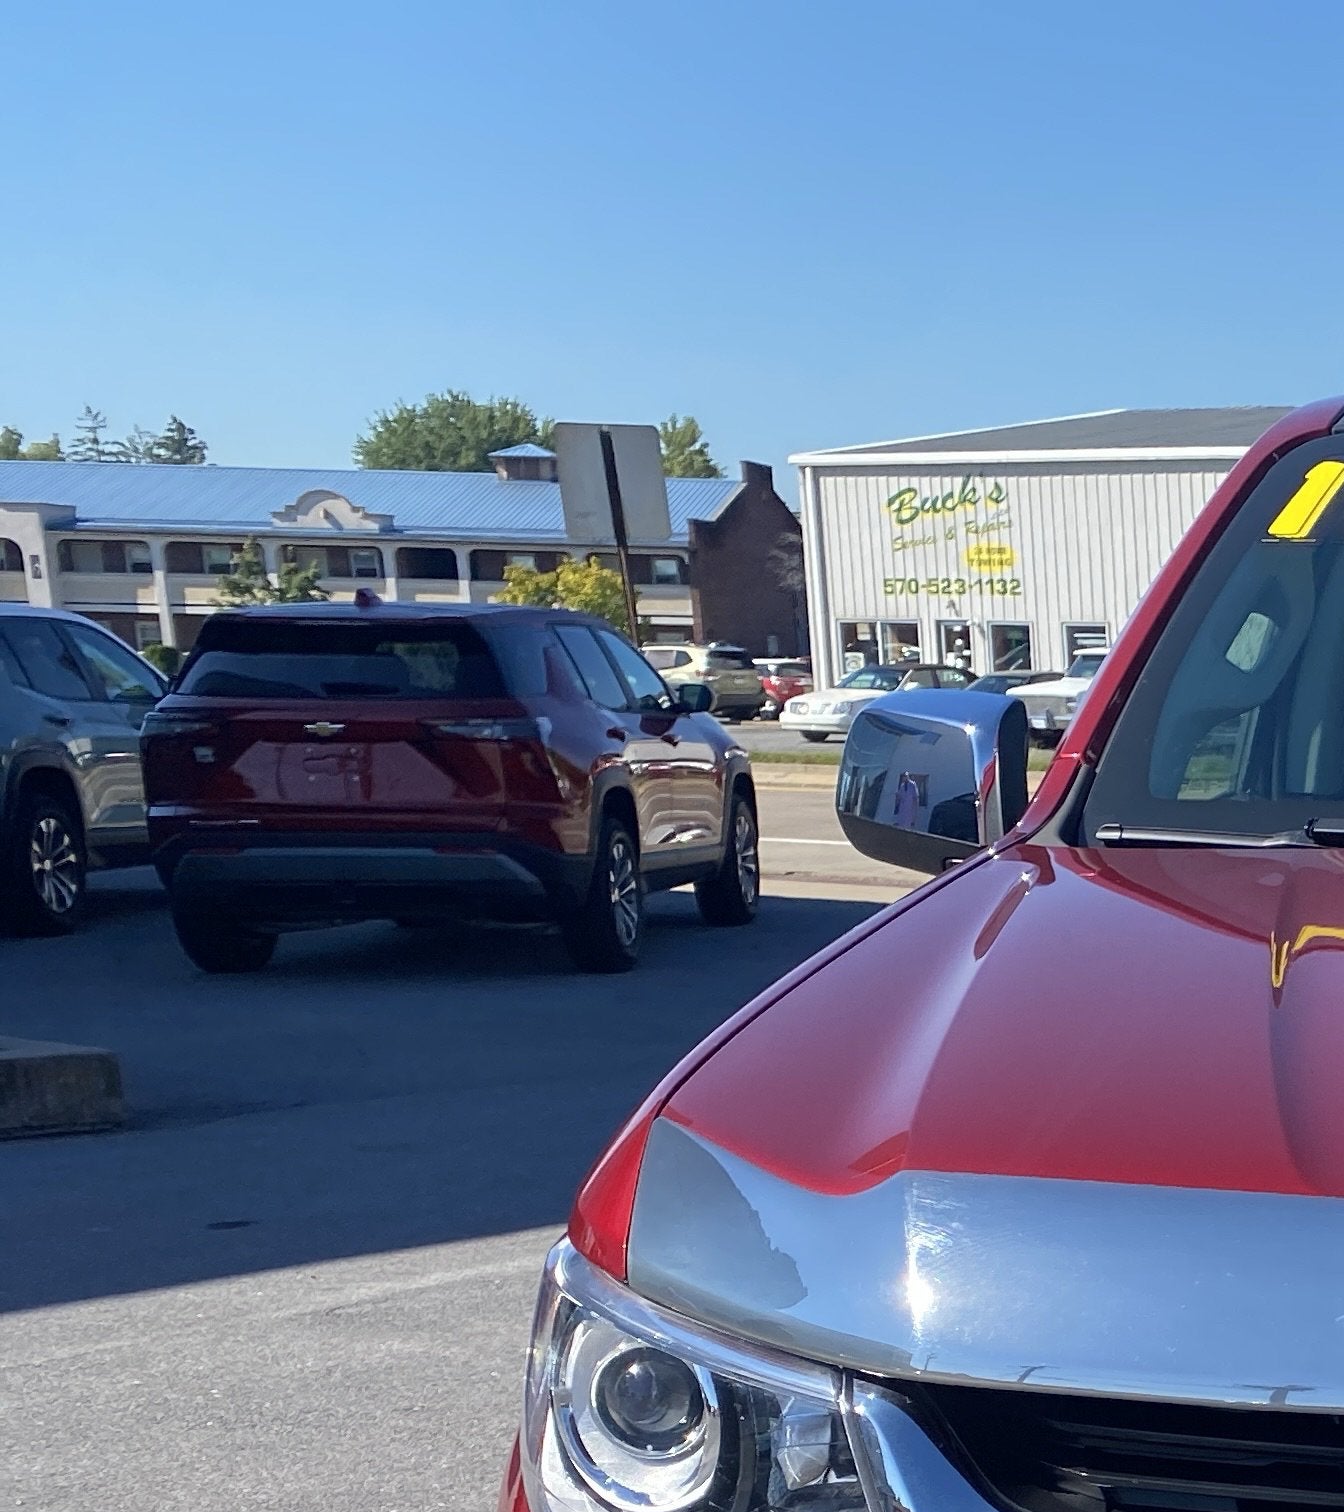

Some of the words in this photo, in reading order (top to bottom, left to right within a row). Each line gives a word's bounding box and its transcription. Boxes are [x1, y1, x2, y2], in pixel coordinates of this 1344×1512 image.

[888, 473, 1008, 524] Buck's
[893, 535, 937, 553] Service
[945, 526, 956, 541] &
[965, 519, 1012, 537] Repairs
[883, 577, 1023, 595] 570-523-1132
